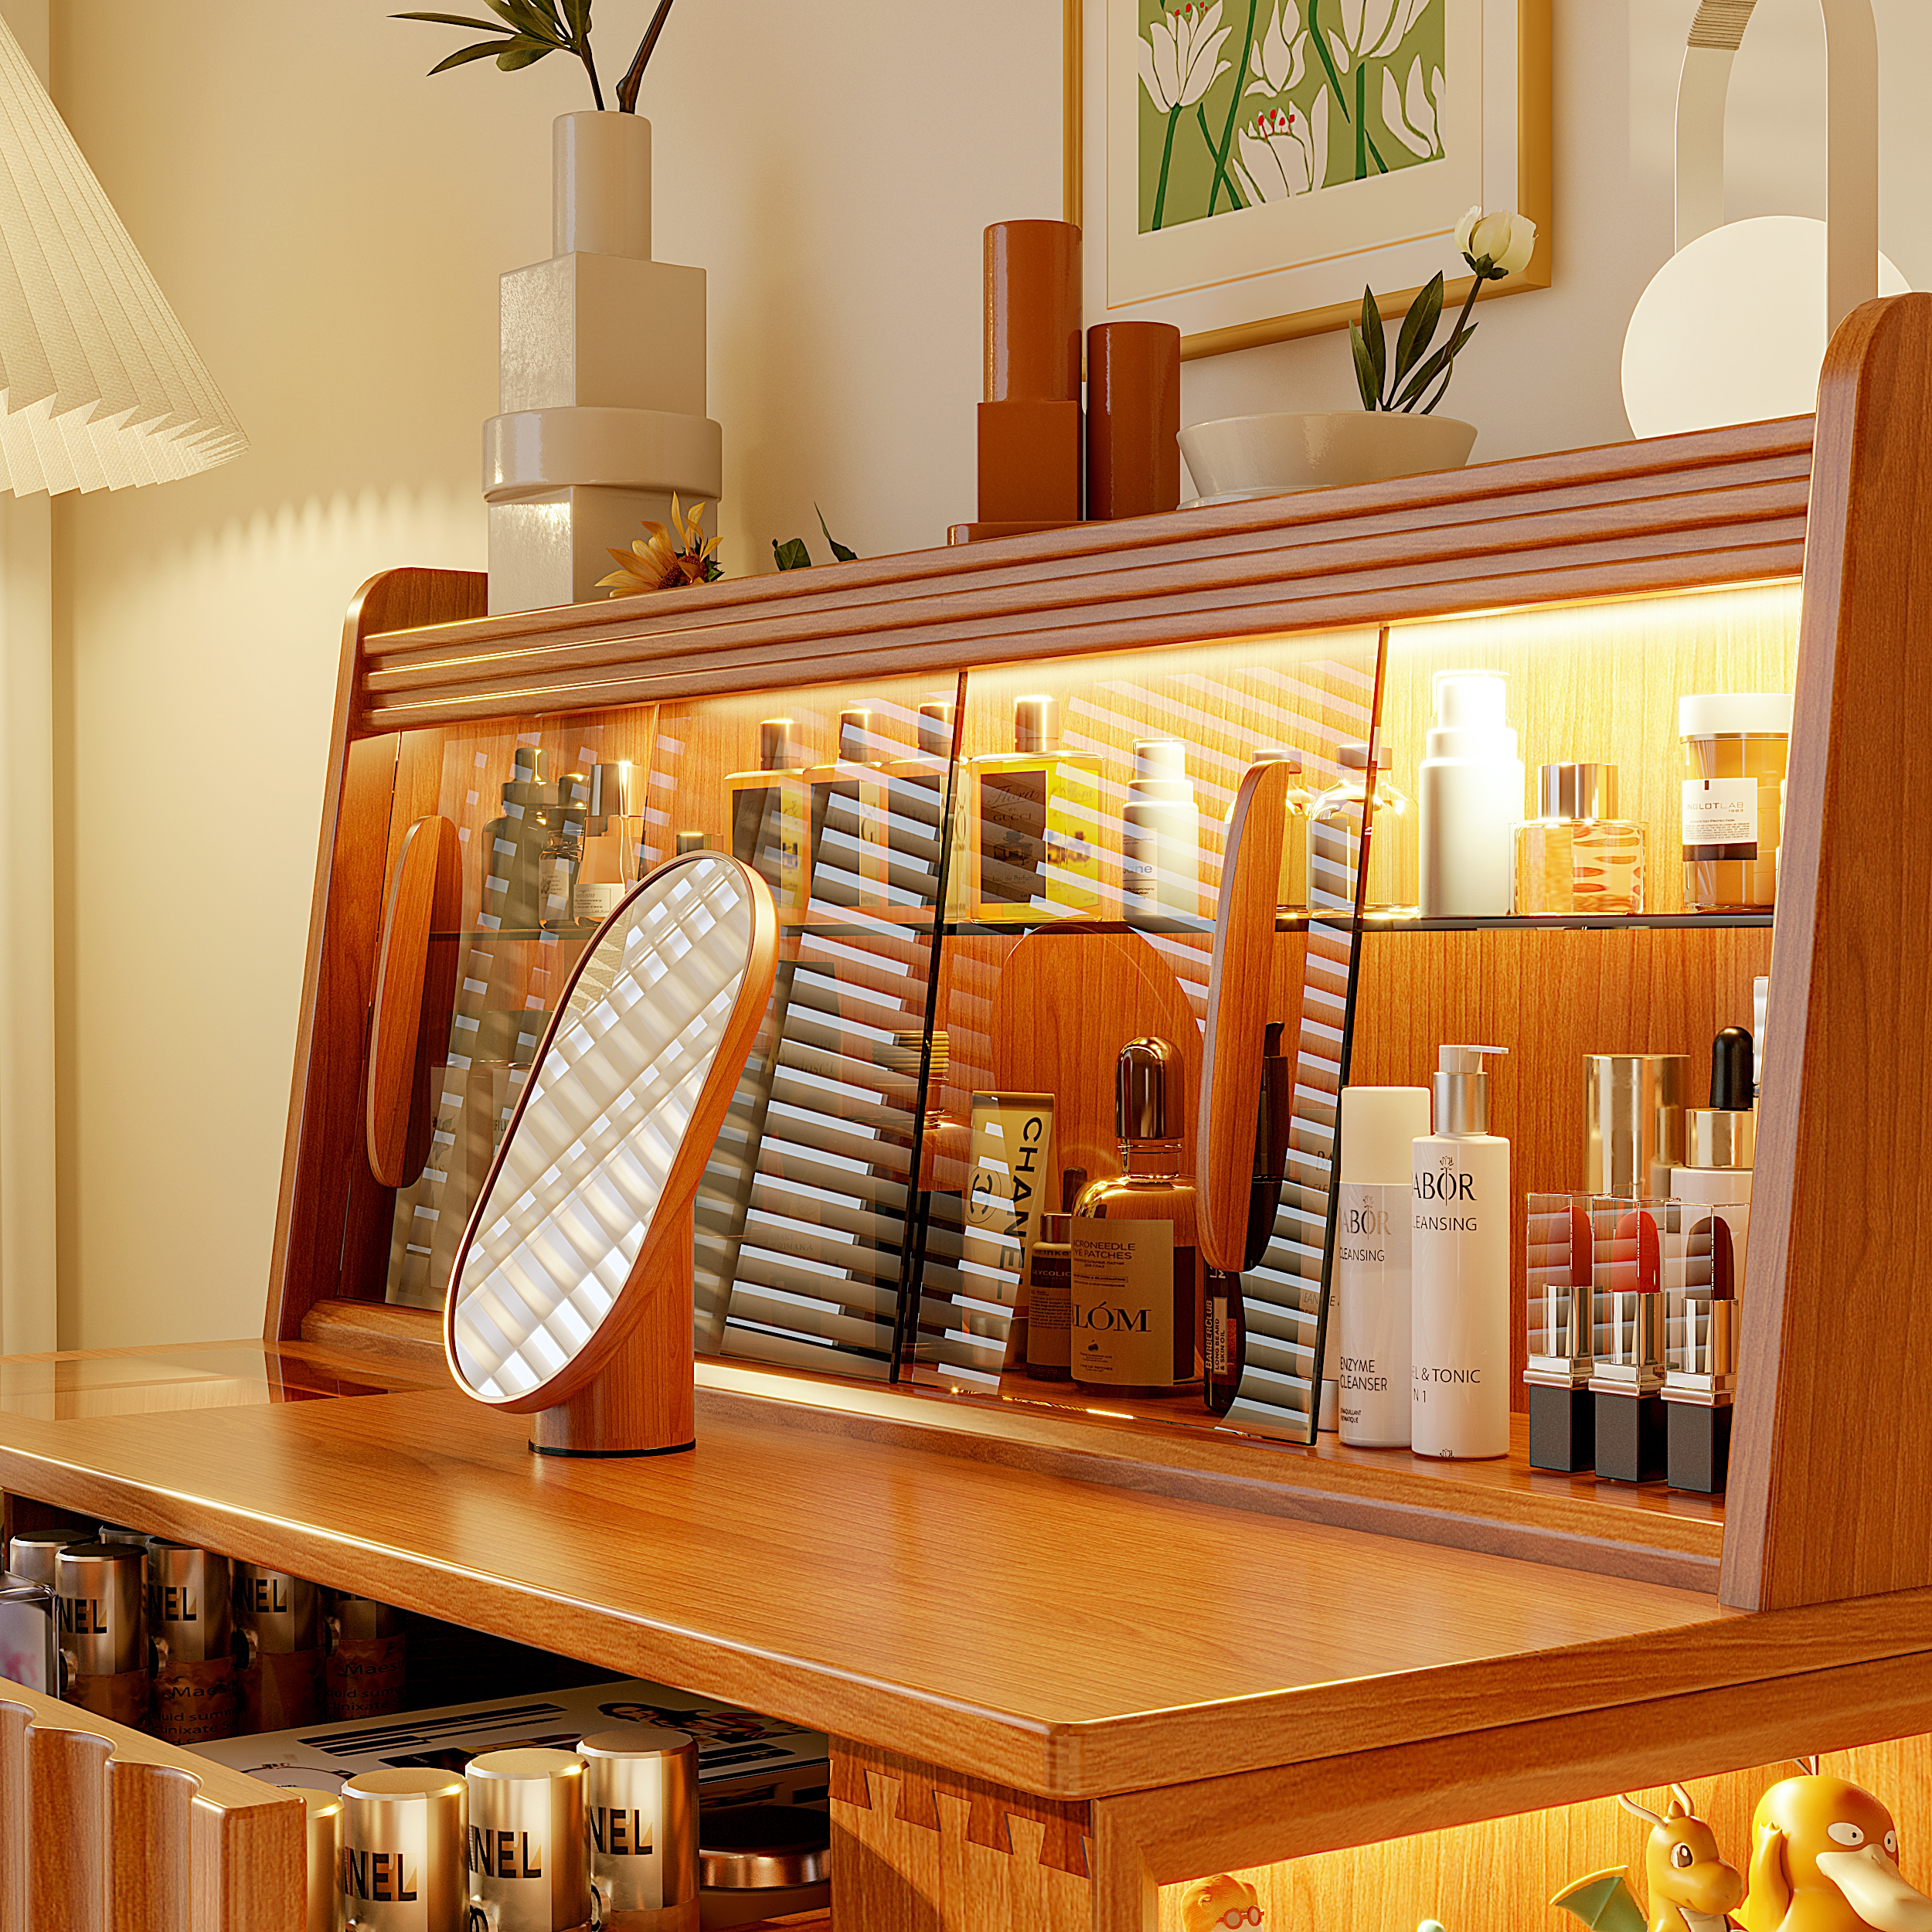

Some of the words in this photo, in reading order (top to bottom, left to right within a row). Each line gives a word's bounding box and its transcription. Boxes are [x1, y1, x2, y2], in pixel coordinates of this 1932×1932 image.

[993, 813, 1032, 821] GUCCI
[1412, 1170, 1478, 1202] ABOR
[997, 1117, 1042, 1300] CHANEL
[1084, 1250, 1133, 1260] PATCHES
[1073, 1301, 1151, 1332] LÓM
[1340, 1356, 1376, 1373] ENZYME
[1340, 1374, 1388, 1391] CLEANSER
[1421, 1367, 1430, 1381] &
[1431, 1369, 1481, 1383] TONIC
[345, 1846, 417, 1902] NEL
